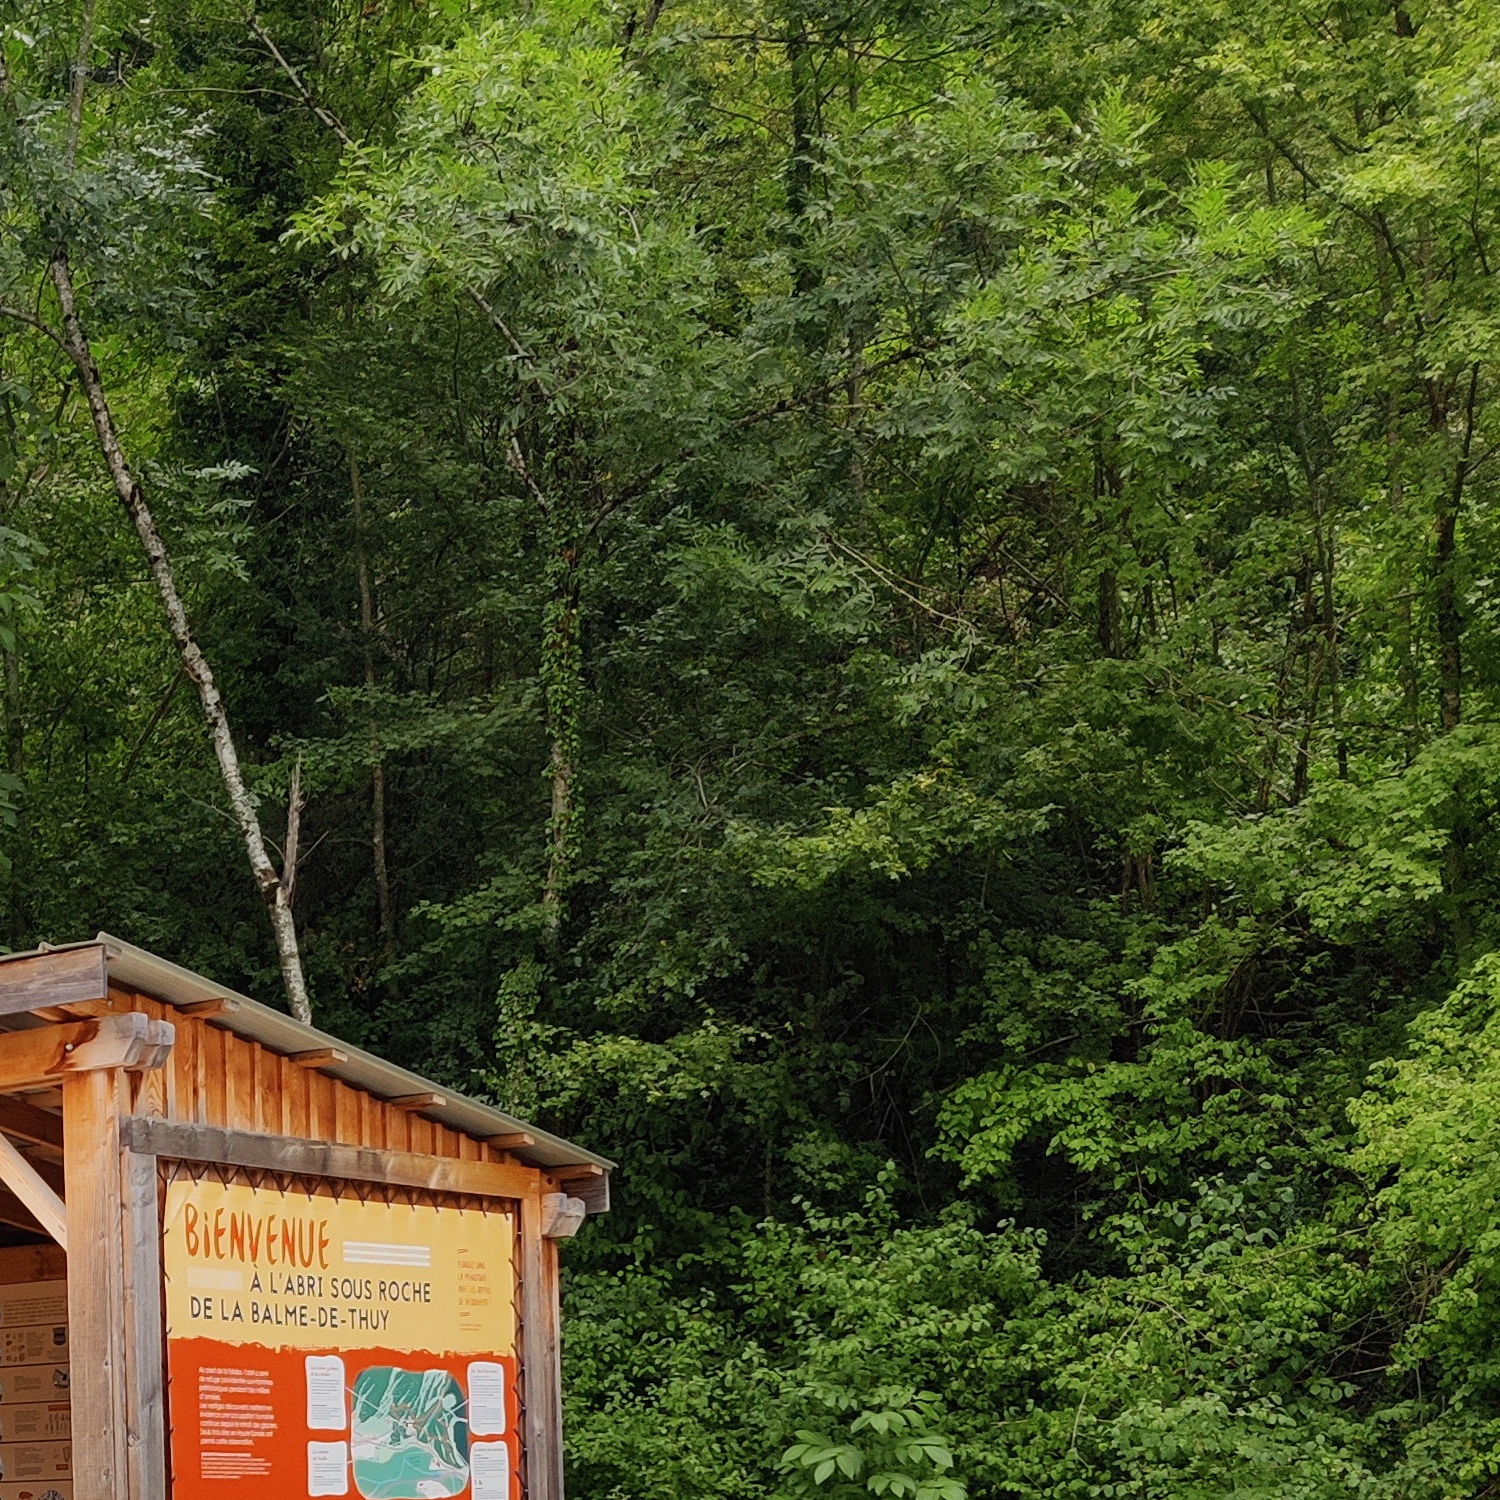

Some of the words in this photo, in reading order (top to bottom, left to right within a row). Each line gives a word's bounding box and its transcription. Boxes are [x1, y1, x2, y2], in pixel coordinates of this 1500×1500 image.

[250, 1264, 262, 1293] À
[270, 1272, 323, 1298] L'ABRI
[331, 1277, 372, 1300] SOUS
[379, 1280, 431, 1303] ROCHE
[190, 1296, 213, 1319] DE
[221, 1299, 244, 1322] LA
[252, 1301, 389, 1330] BALME-DE-THUY
